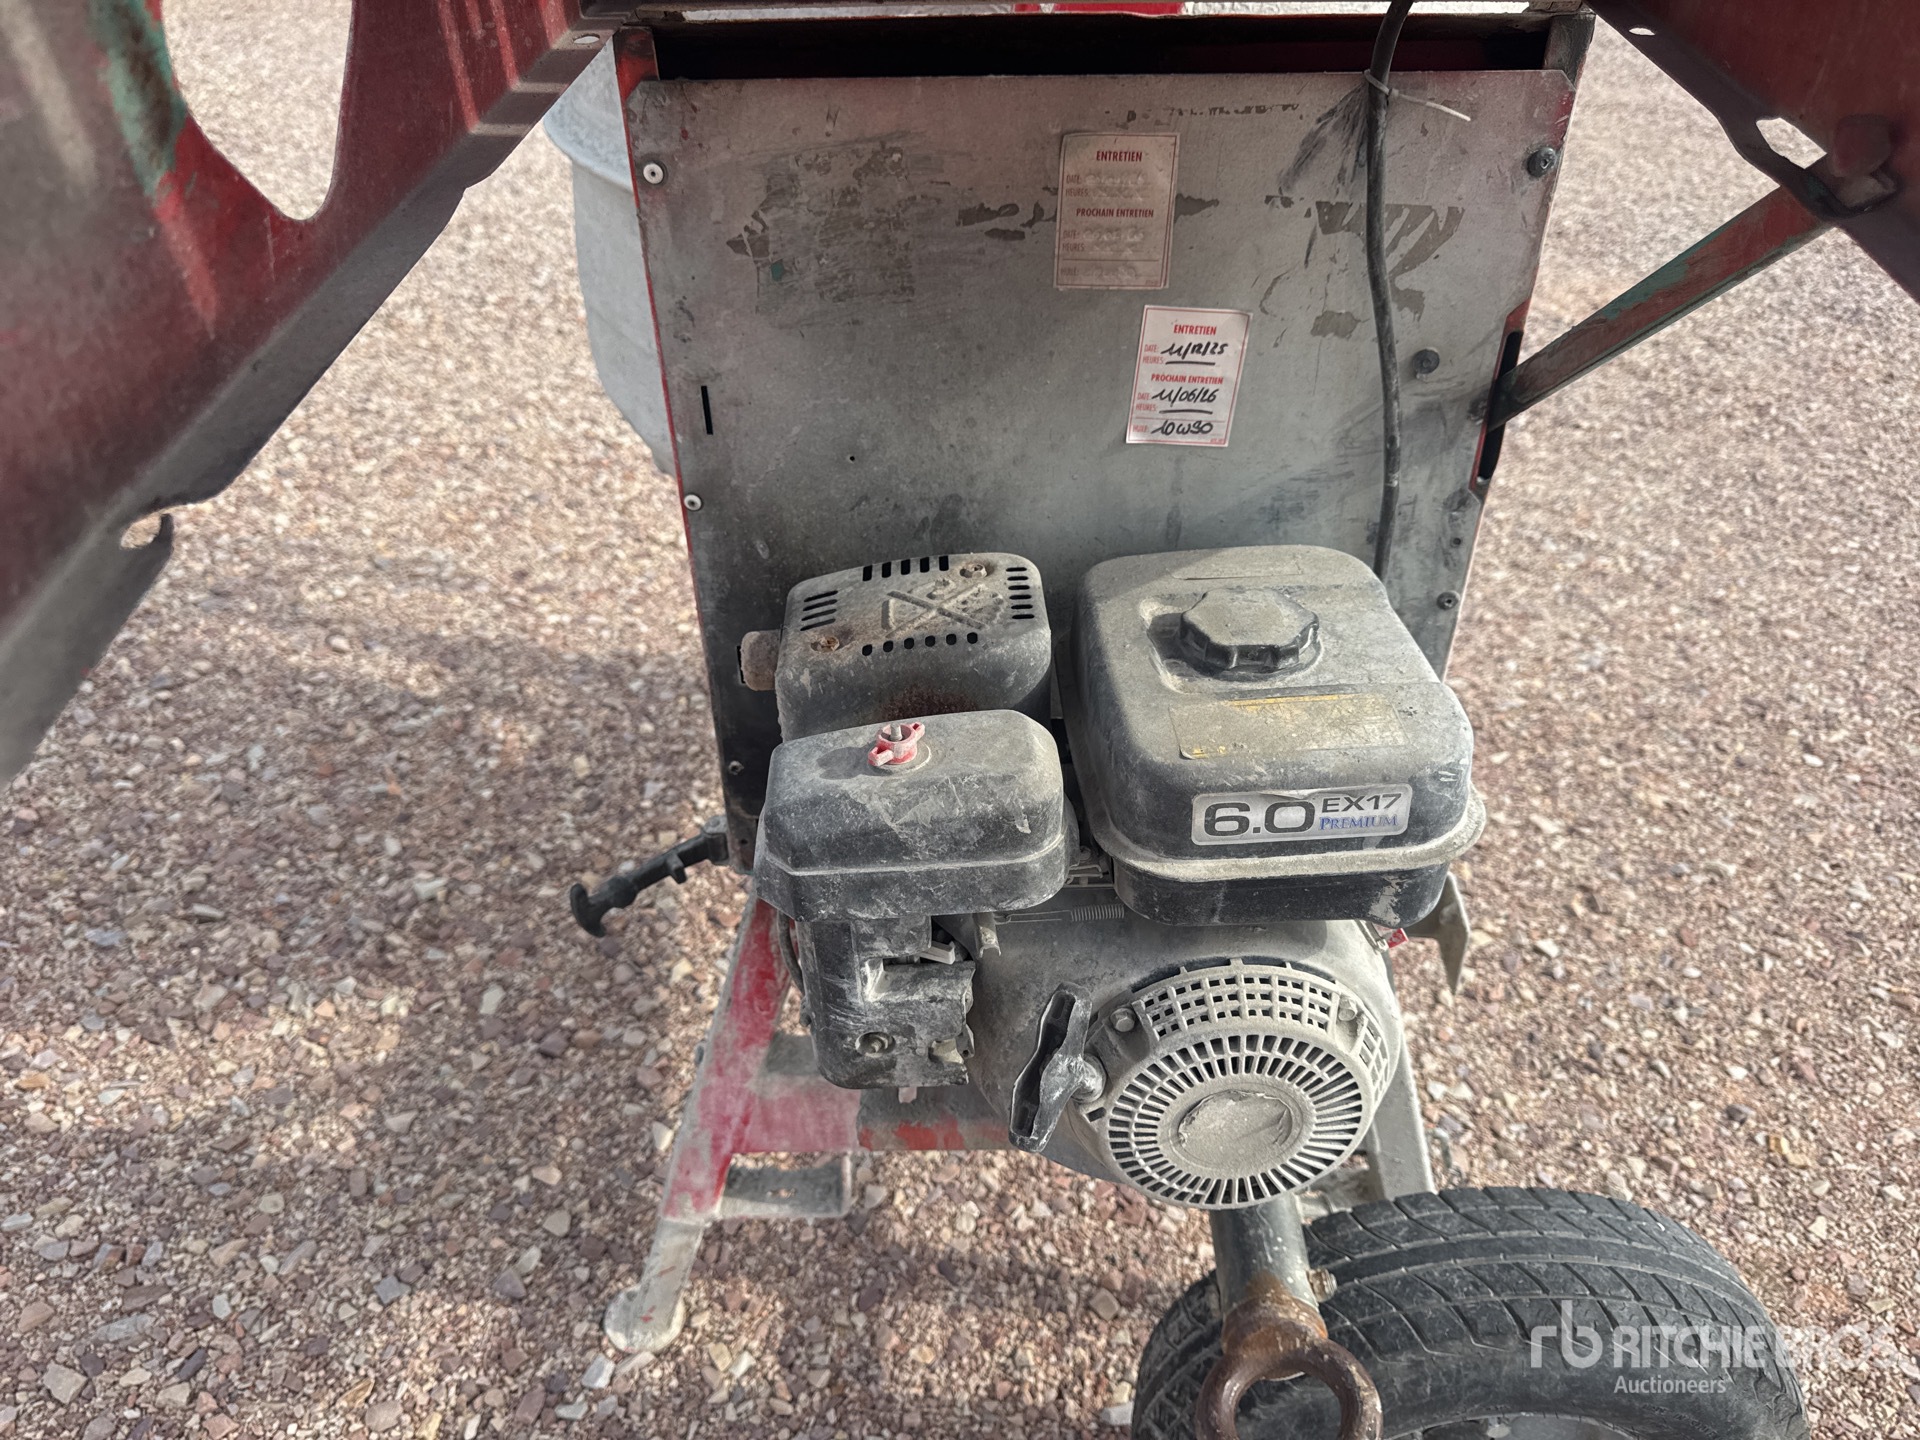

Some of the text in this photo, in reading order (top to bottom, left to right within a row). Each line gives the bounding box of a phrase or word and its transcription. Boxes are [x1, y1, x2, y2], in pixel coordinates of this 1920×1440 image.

[1096, 151, 1143, 162] ENTRETIEN
[1076, 208, 1154, 218] PROCHAIN ENTRETIEN
[1173, 324, 1217, 335] ENTRETIEN
[1160, 341, 1228, 360] 11/12/25
[1151, 373, 1223, 385] PROCHAIN ENTRETIEN
[1151, 386, 1219, 407] 11/06/26
[1321, 793, 1402, 814] EX17
[1204, 801, 1316, 838] 6.0
